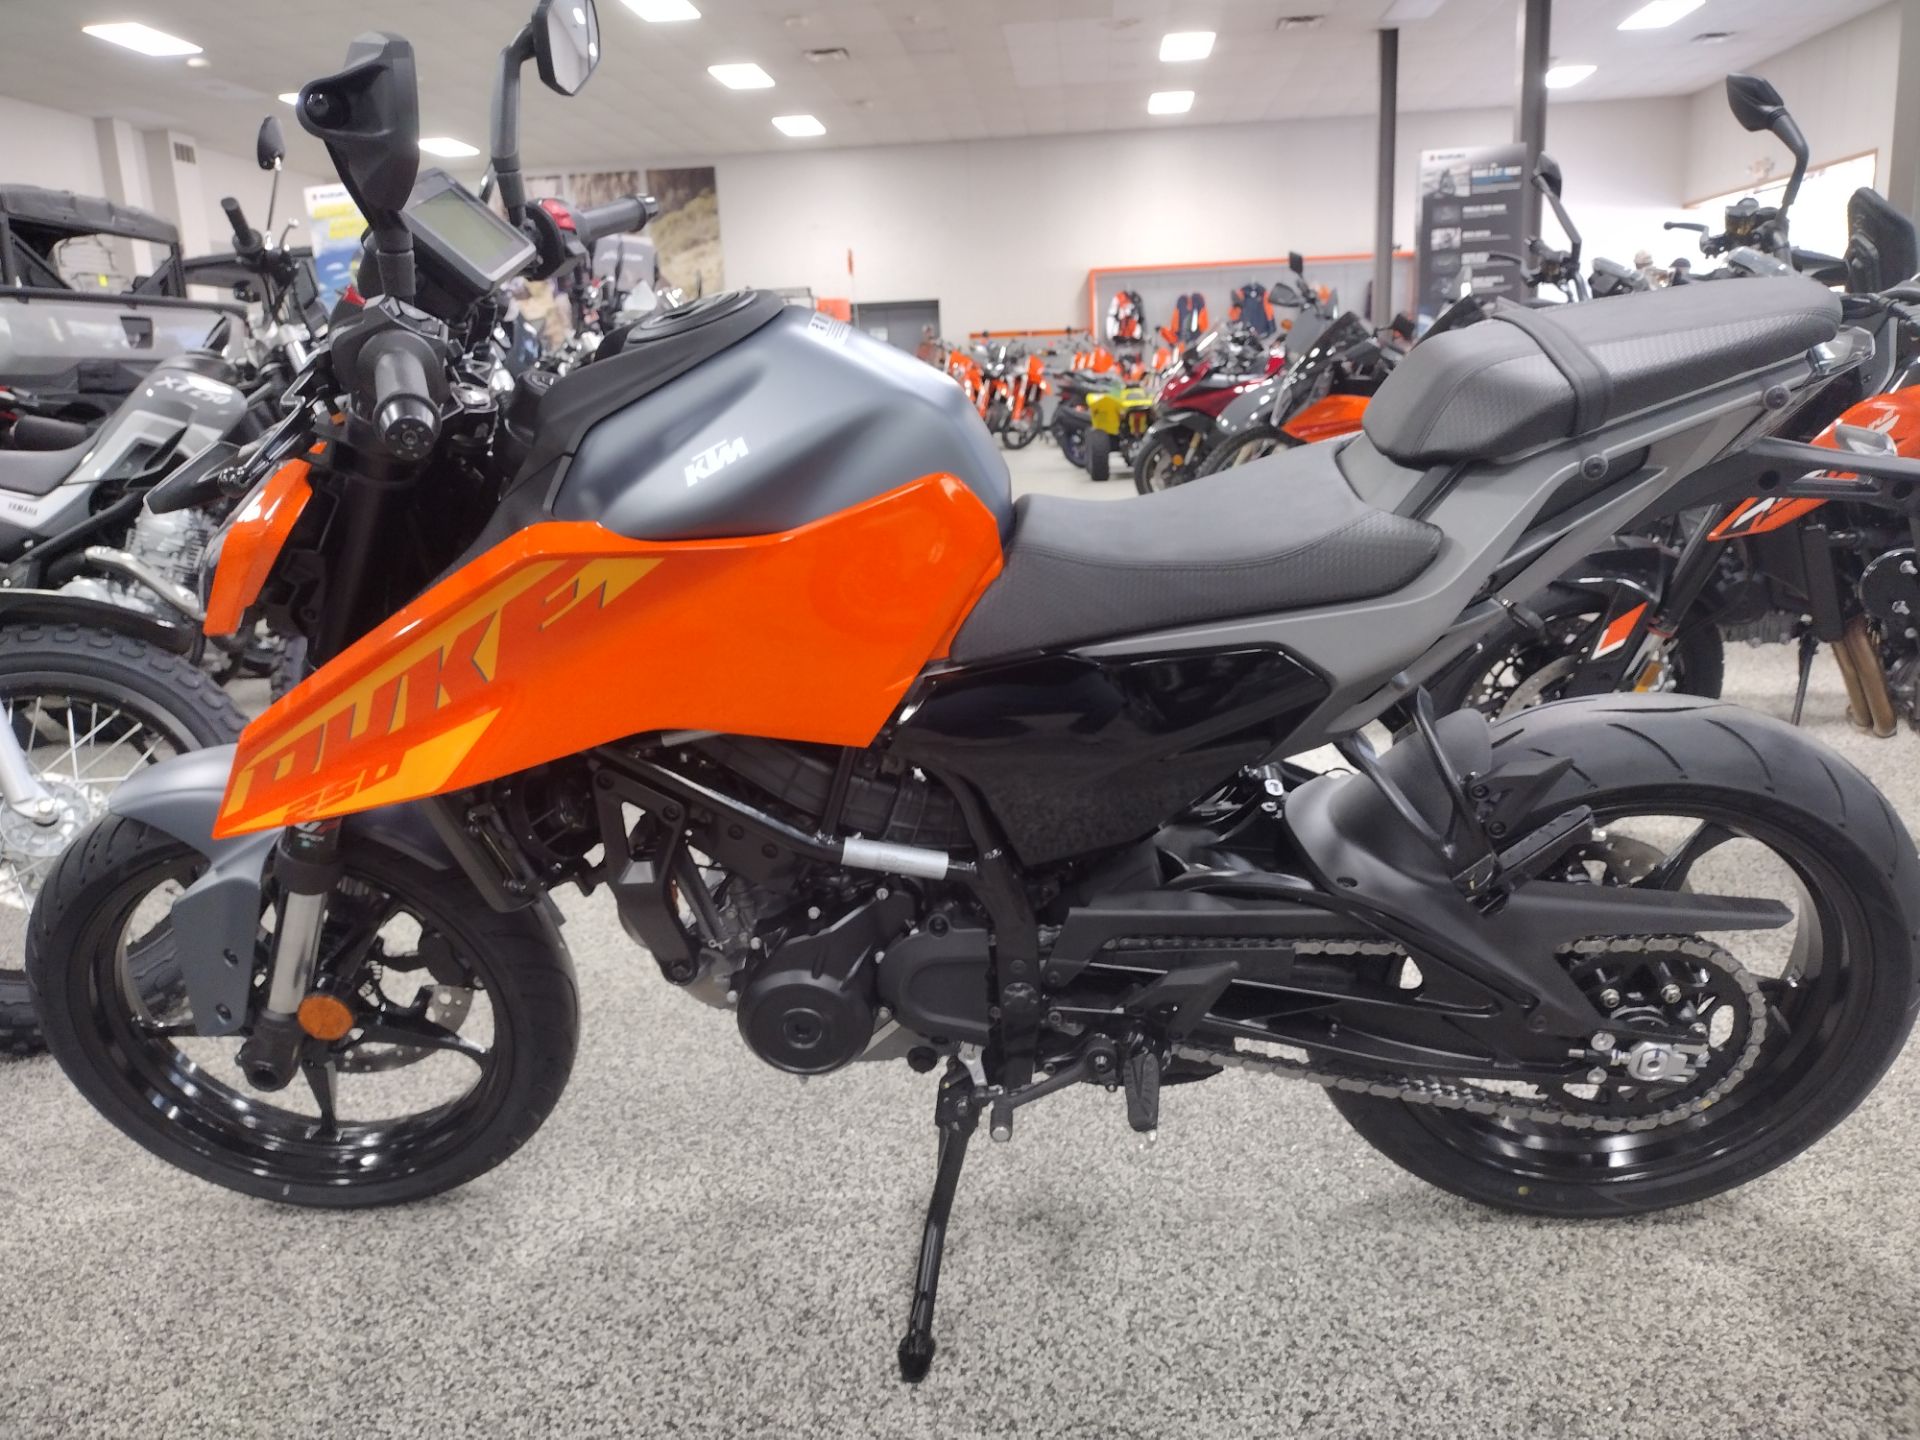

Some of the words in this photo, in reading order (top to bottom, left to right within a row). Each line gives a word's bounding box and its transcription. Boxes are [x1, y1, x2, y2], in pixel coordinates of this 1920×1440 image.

[684, 436, 749, 487] KTM
[244, 559, 608, 792] DUKE
[282, 758, 402, 825] 250
